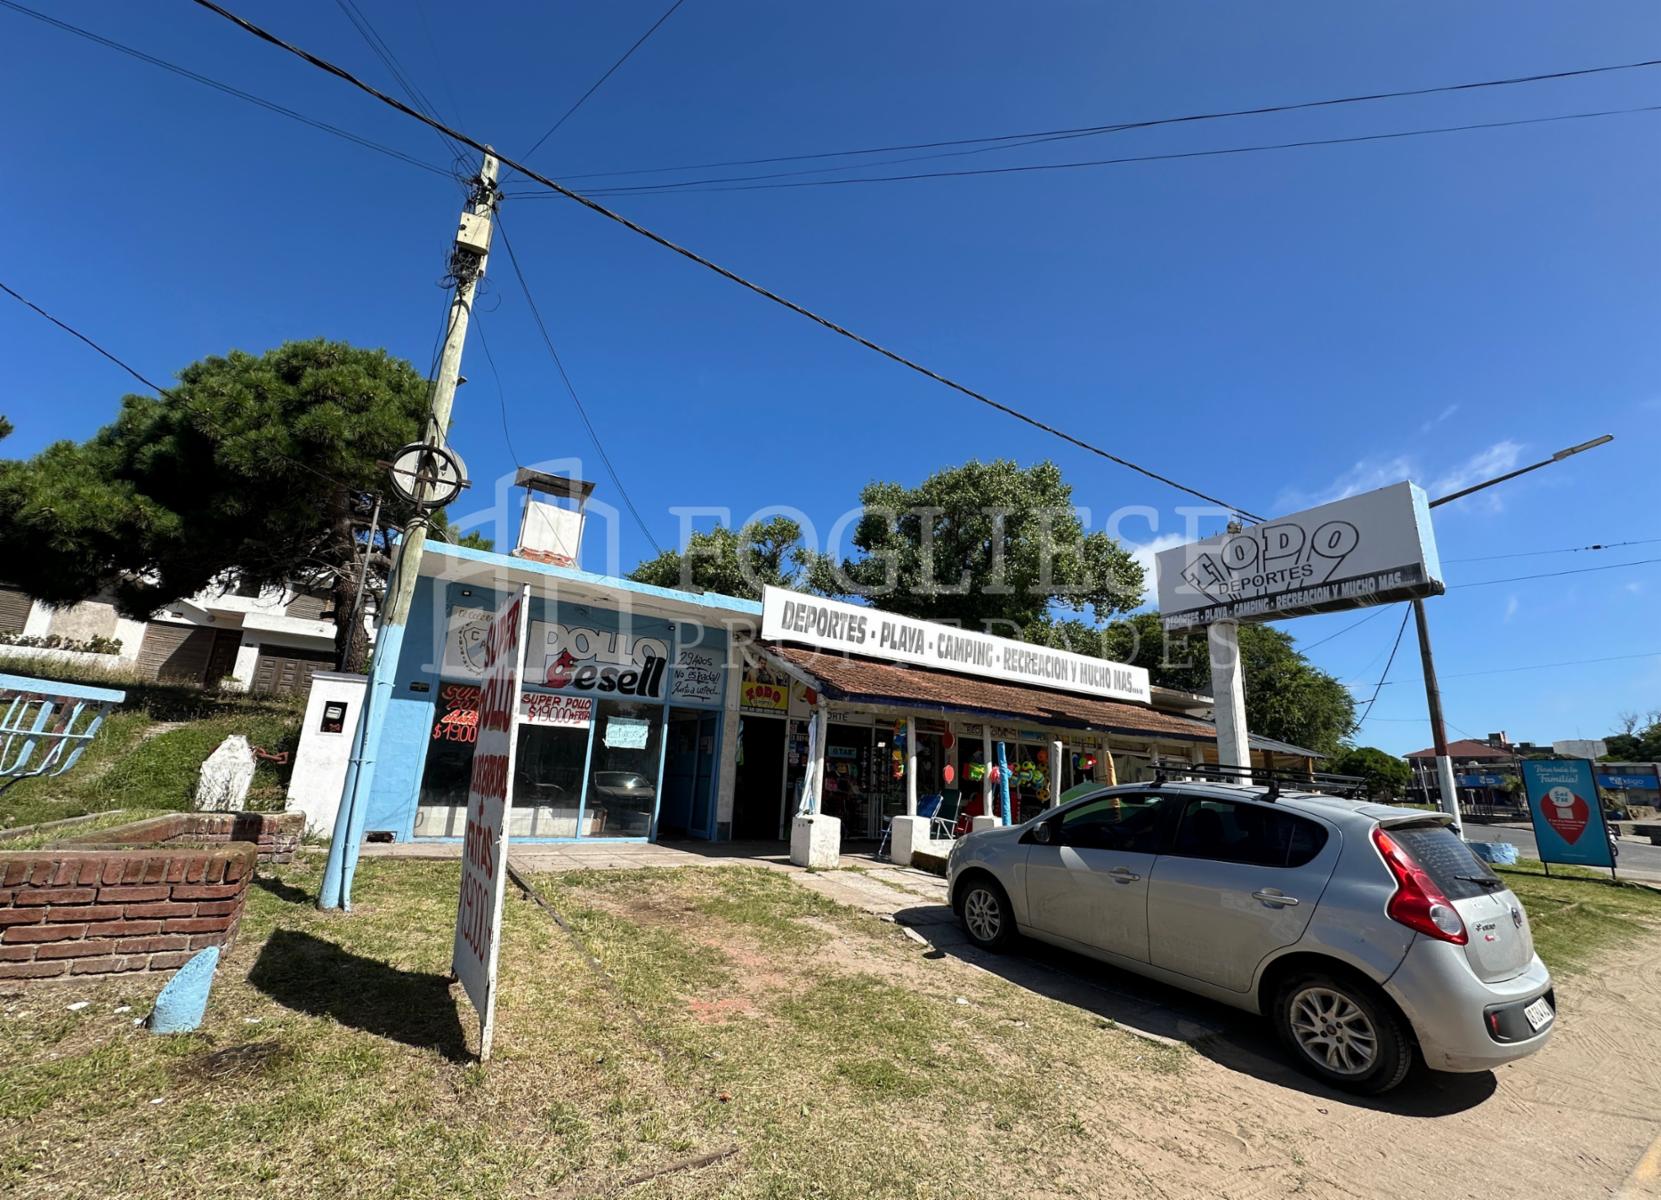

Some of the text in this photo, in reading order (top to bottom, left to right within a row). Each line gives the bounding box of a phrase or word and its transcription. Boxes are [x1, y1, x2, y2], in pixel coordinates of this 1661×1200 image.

[1219, 564, 1313, 595] DEPORTES
[1205, 606, 1228, 622] PLAYA
[1233, 598, 1270, 617] CAMPING
[1276, 586, 1330, 610] RECREACION
[1332, 581, 1342, 598] Y
[1341, 577, 1377, 597] MUCHO
[781, 600, 868, 645] DEPORTES
[879, 621, 925, 655] PLAYA
[937, 633, 993, 668] CAMPING
[1003, 646, 1069, 682] RECREACION
[1070, 660, 1078, 683] Y
[1079, 662, 1111, 690] MUCHO
[520, 693, 592, 710] SUPER POLLO
